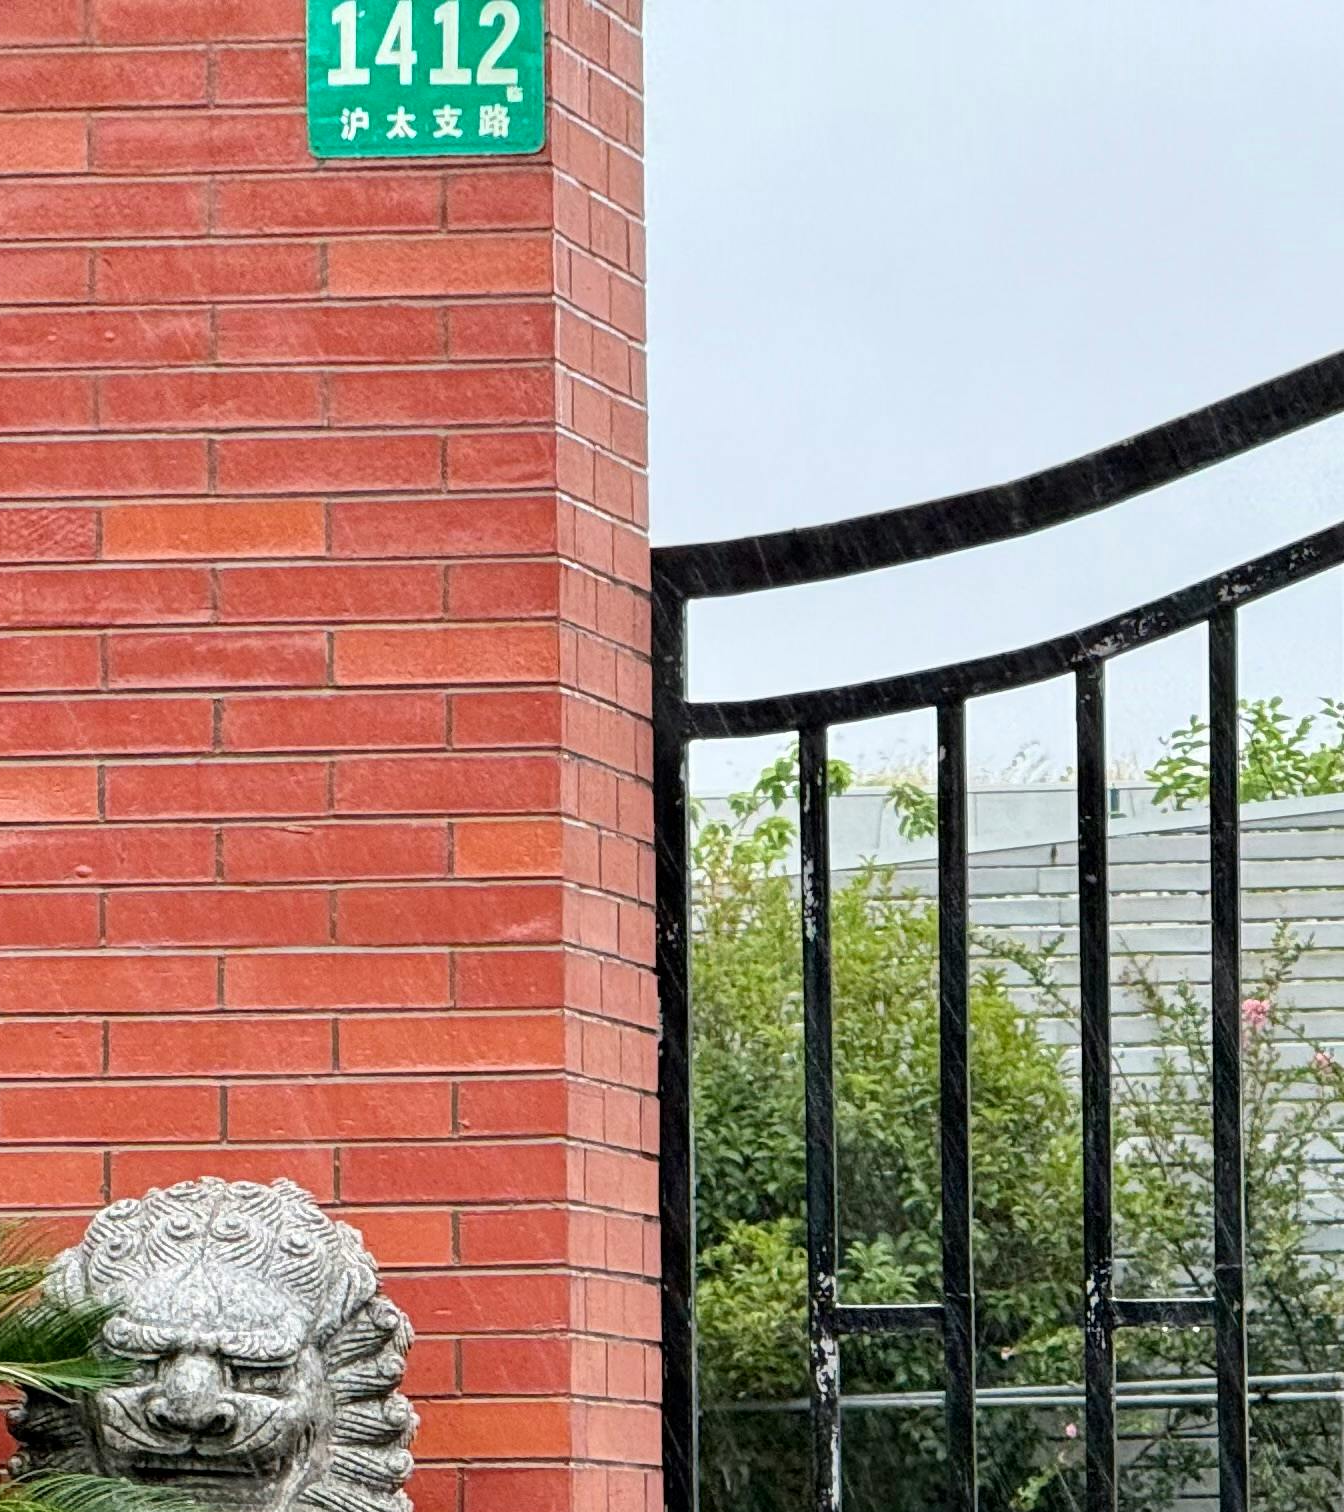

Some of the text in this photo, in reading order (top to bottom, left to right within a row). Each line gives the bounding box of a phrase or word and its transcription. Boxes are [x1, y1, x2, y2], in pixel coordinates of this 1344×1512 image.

[327, 0, 520, 85] 1412
[340, 104, 510, 140] 沪太支路
